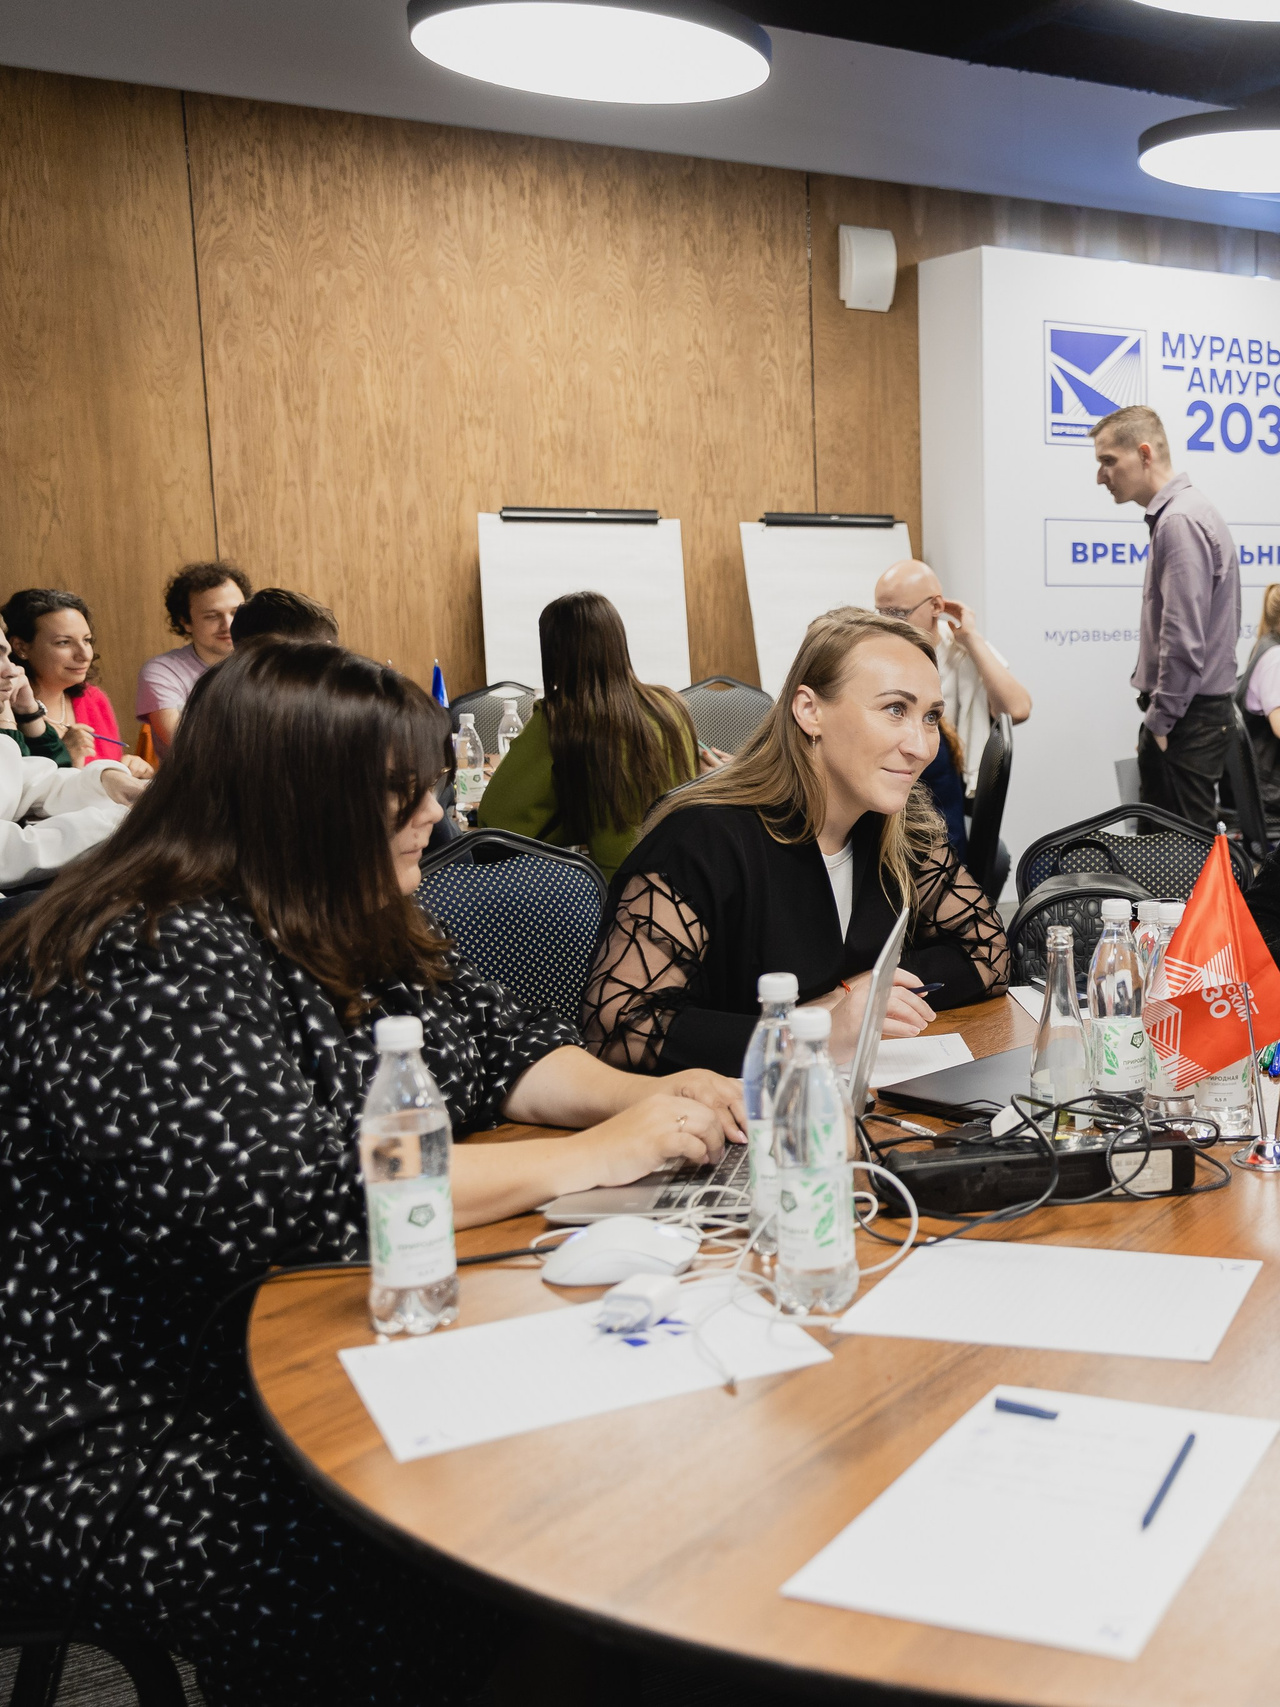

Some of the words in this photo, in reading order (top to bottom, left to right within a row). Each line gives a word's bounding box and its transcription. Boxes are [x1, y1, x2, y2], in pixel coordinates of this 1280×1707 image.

[1071, 542, 1151, 565] ВРЕМ
[1044, 630, 1140, 646] муравьева
[1201, 985, 1231, 1019] 30
[1225, 984, 1253, 1022] СКИЙ
[1122, 1055, 1147, 1066] ПРИРОДН
[1207, 1074, 1239, 1082] РИРОДНАЯ
